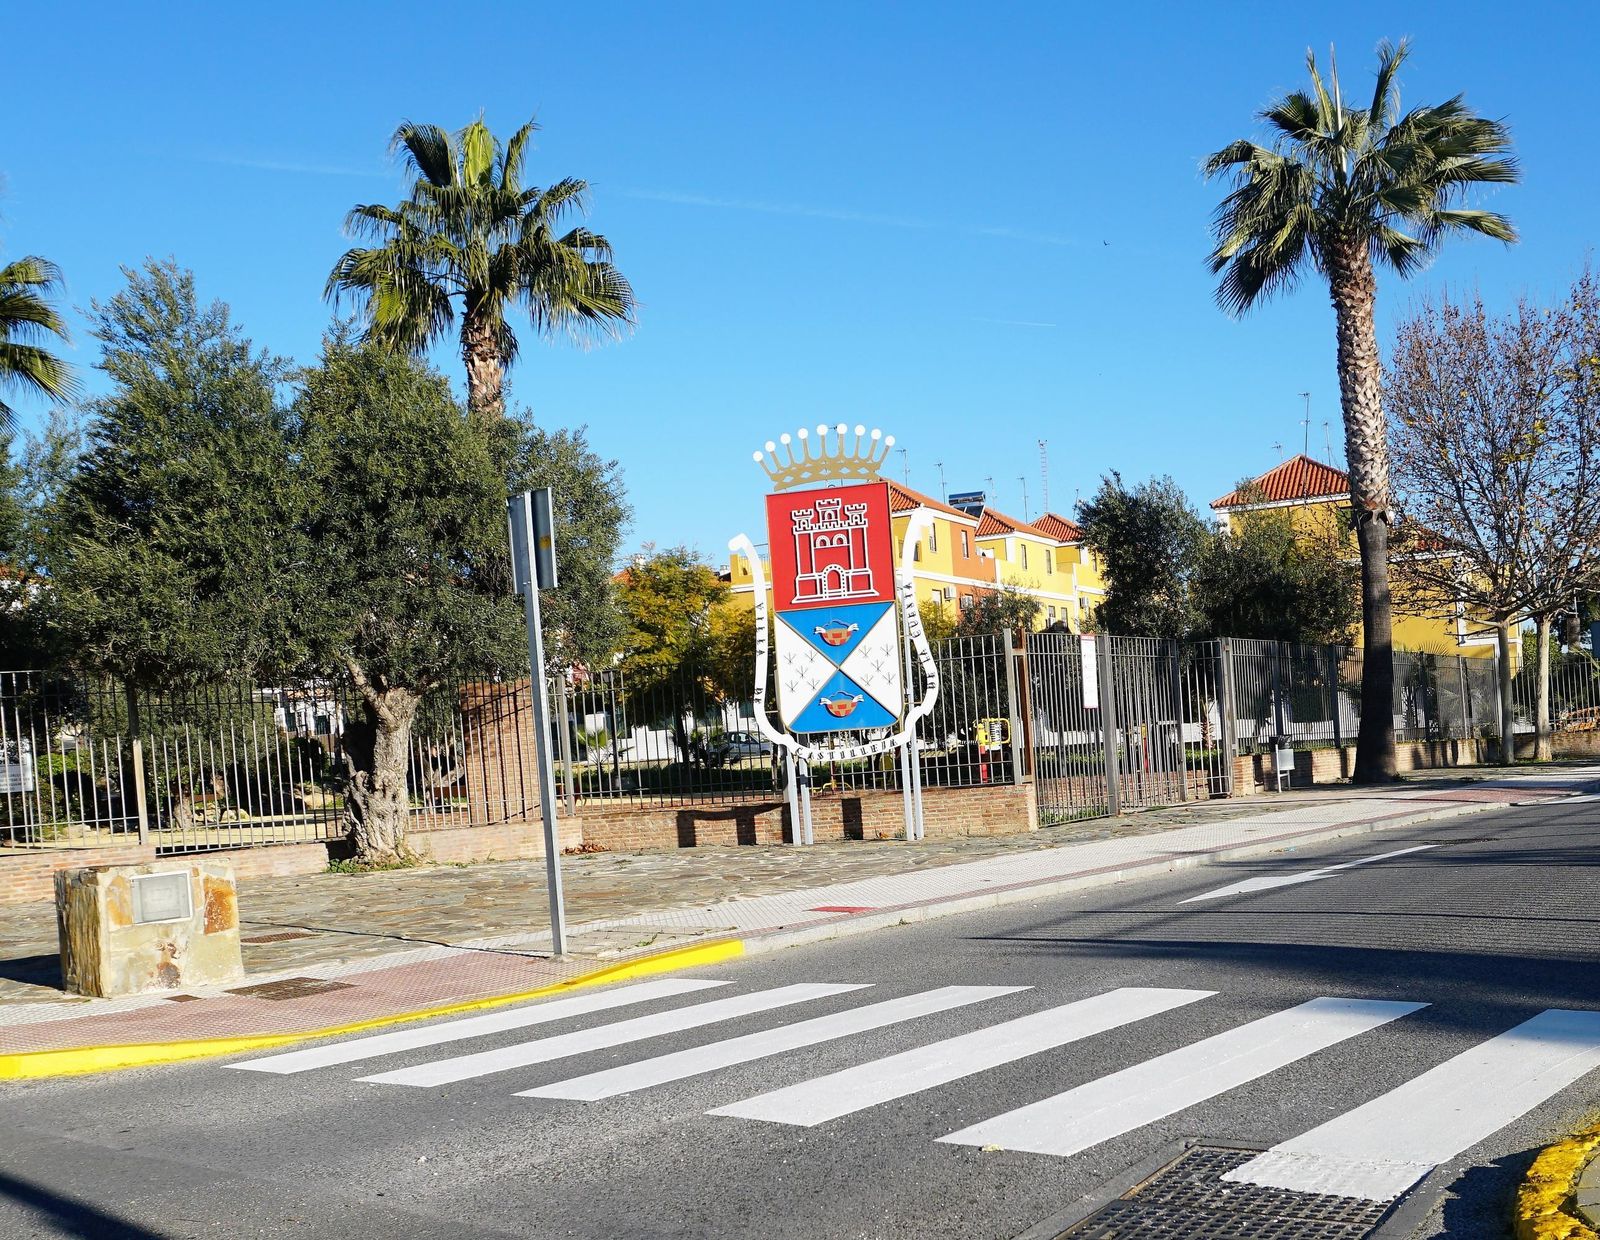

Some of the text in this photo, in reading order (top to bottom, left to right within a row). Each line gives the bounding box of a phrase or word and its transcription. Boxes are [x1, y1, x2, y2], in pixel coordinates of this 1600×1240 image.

[903, 582, 922, 639] CUESTA
[754, 602, 766, 705] VILLA DE
[926, 672, 936, 690] DE
